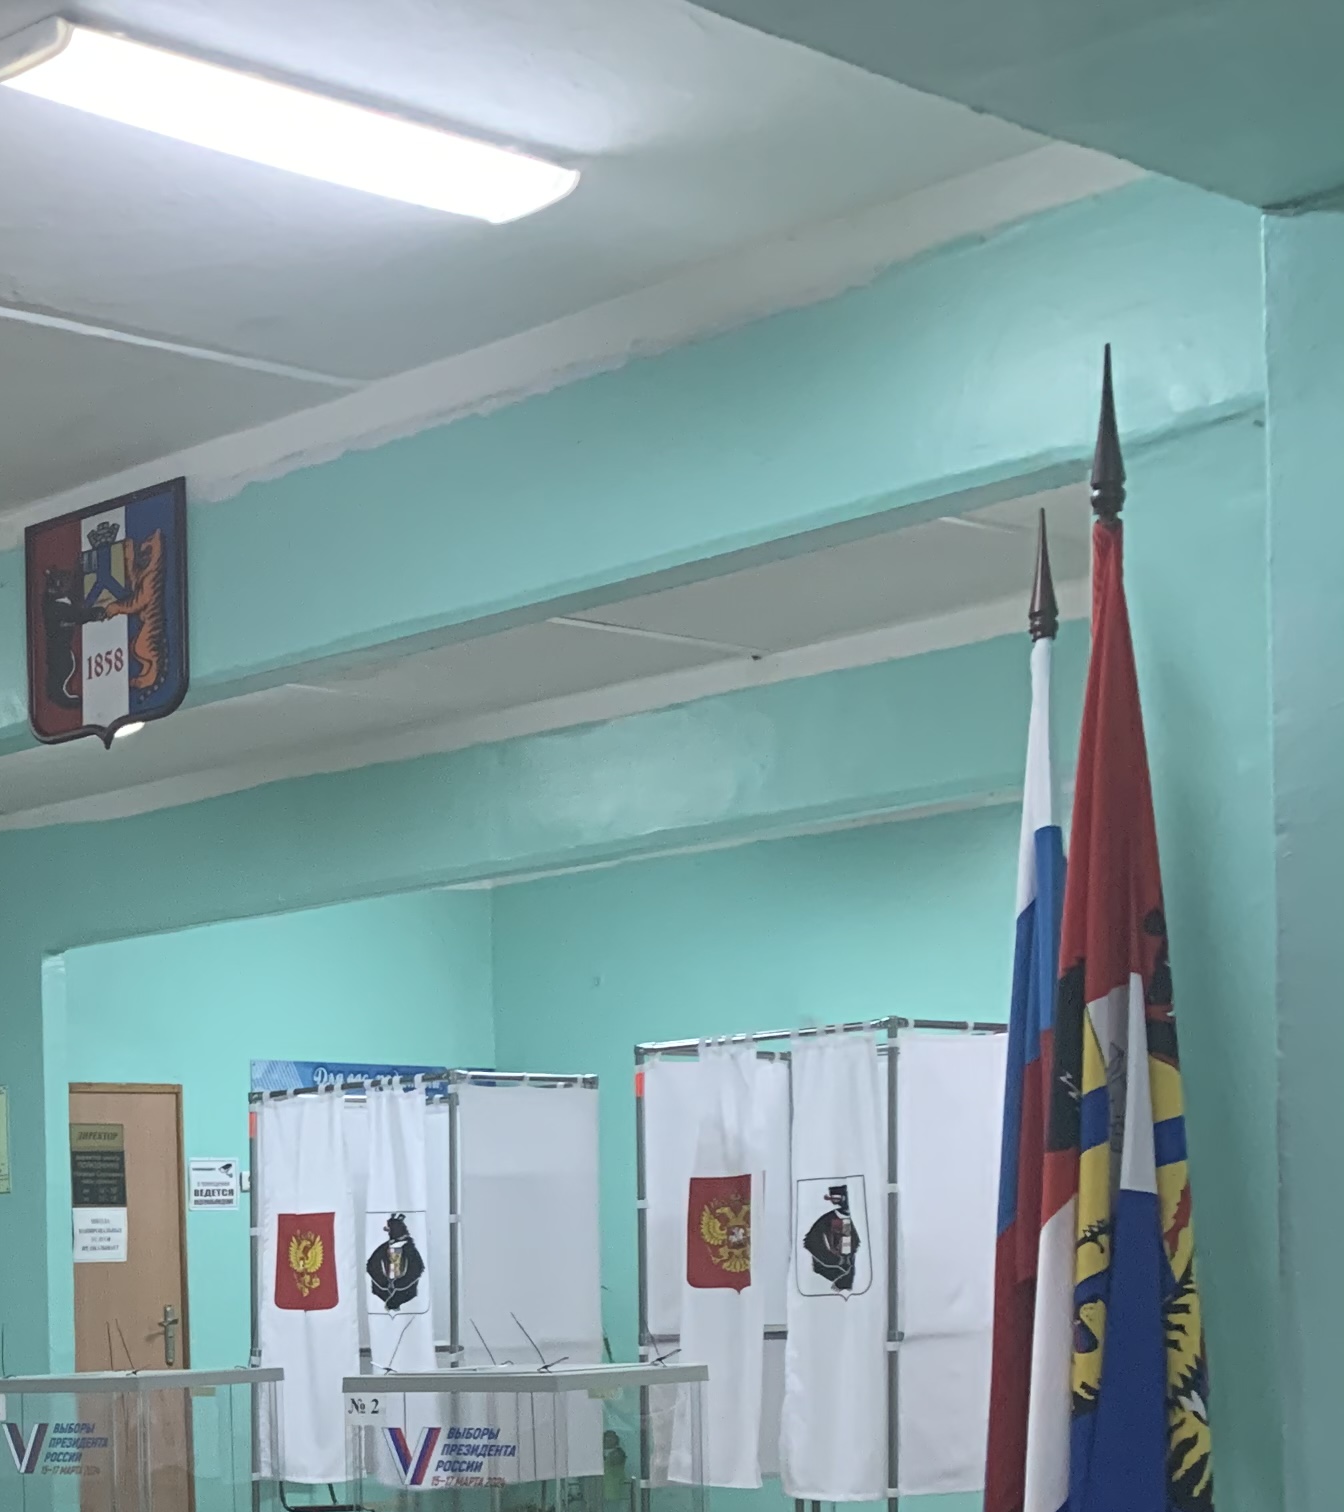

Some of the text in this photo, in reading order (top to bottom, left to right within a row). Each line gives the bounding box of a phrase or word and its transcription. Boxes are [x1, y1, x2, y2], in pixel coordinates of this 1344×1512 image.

[87, 647, 124, 680] 1858
[348, 1398, 380, 1414] № 2
[52, 1423, 95, 1434] ВЫБОРЫ
[446, 1428, 500, 1440] ВЫБОРЫ
[48, 1437, 109, 1449] ПРЕЗИДЕНТА
[441, 1444, 517, 1458] ПРЕЗИДЕНТА
[44, 1452, 82, 1463] РОССИИ
[435, 1460, 483, 1473] РОССИИ
